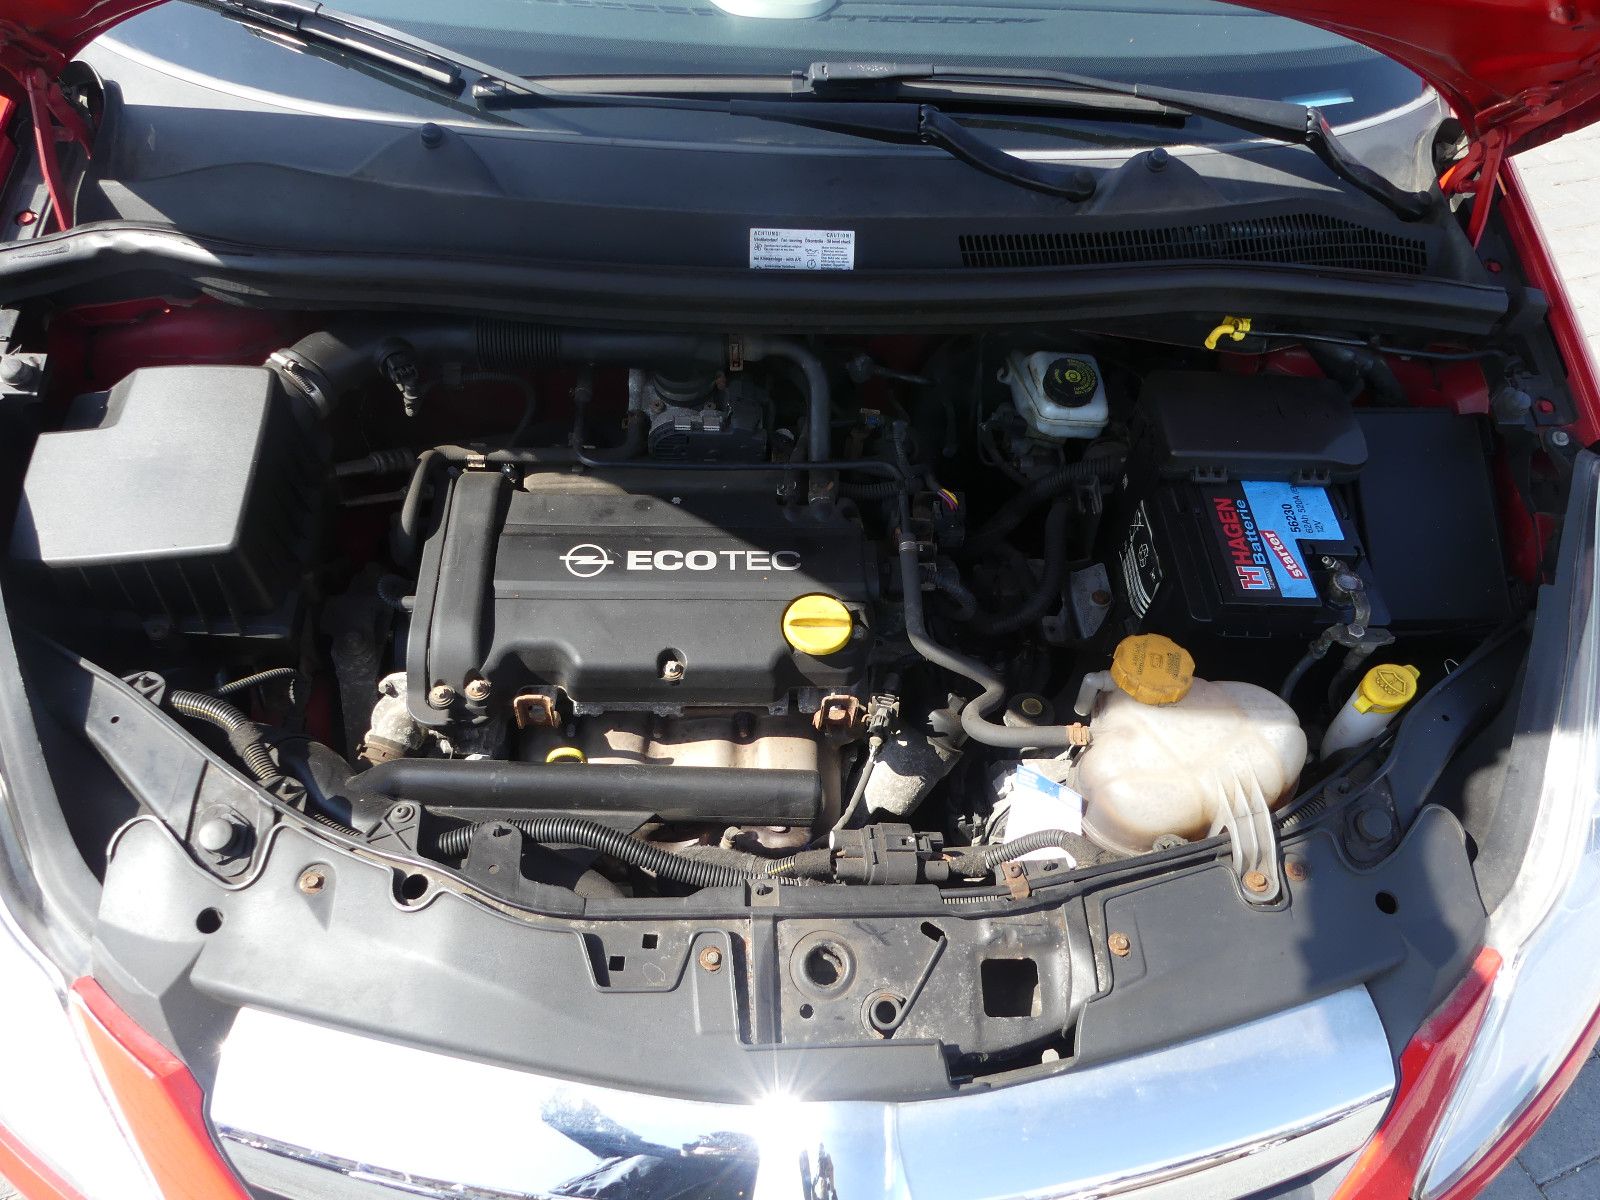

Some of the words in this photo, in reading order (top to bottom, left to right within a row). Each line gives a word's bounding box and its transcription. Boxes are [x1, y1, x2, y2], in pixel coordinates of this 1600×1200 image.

[1292, 495, 1306, 513] 520A
[1281, 503, 1301, 533] 56230
[1301, 514, 1314, 534] 62Ah
[1312, 519, 1324, 533] 12V
[1213, 497, 1254, 566] HAGEN
[1237, 500, 1266, 565] Batterie
[626, 550, 802, 571] ECOTEC
[1264, 532, 1303, 578] starter
